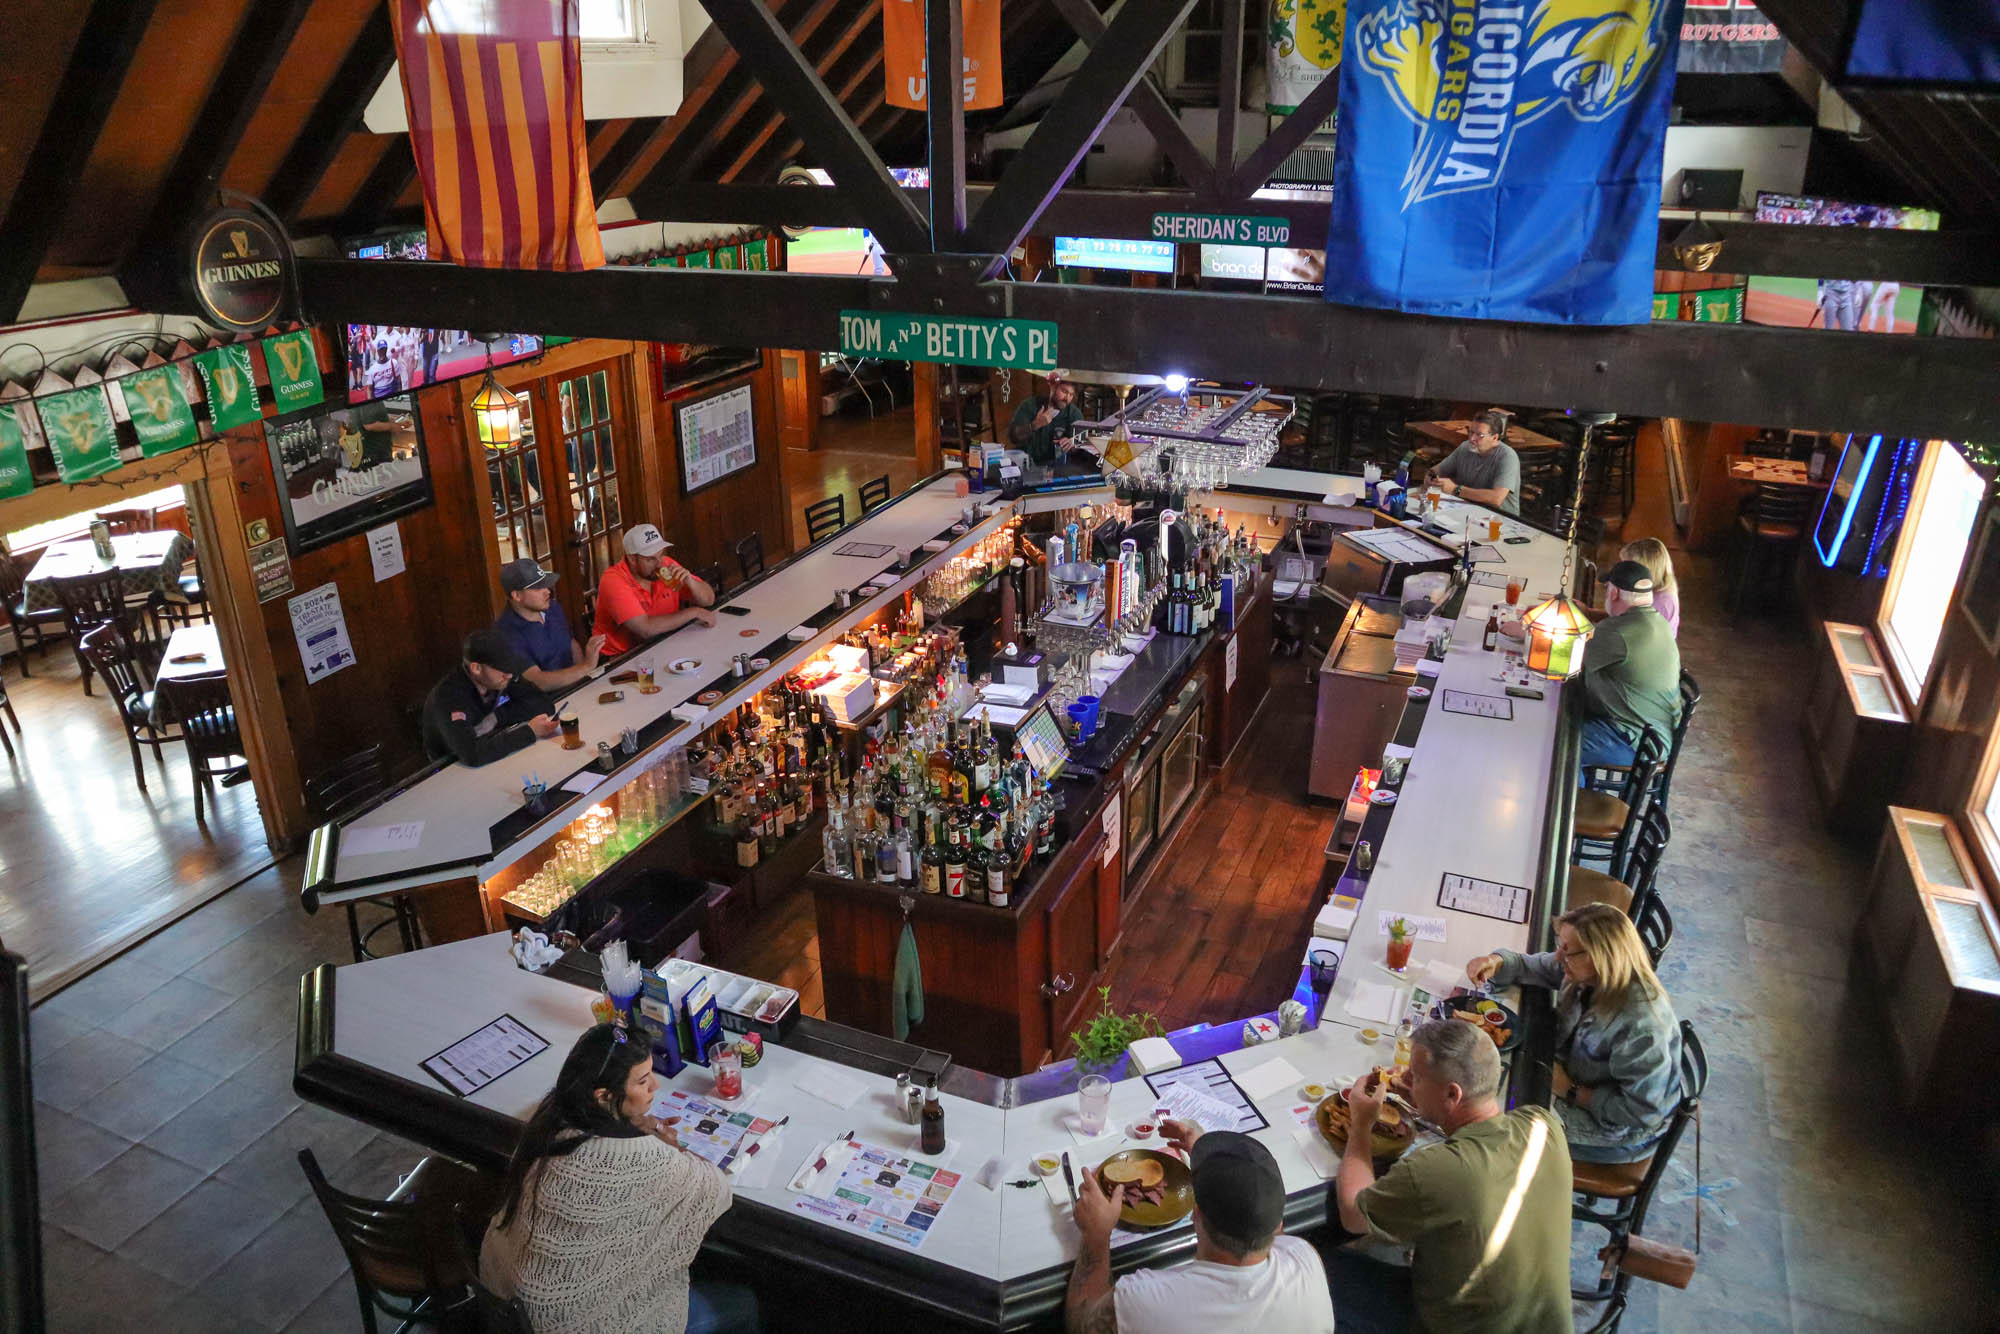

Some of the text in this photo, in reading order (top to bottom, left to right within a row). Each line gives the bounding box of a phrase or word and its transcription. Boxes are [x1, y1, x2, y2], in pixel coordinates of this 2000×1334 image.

[1680, 23, 1779, 41] RUTGERS
[1434, 0, 1525, 186] ICORDIA
[1153, 216, 1290, 243] SHERIDAN'S BLVD
[363, 247, 380, 257] LIVE
[204, 260, 281, 284] GUINNESS
[841, 316, 882, 351] TOM
[927, 323, 1018, 361] BETTY'S
[1028, 328, 1056, 364] PL
[195, 361, 218, 425] GUINNESS
[280, 379, 315, 395] GUINNESS
[304, 595, 324, 610] 2024
